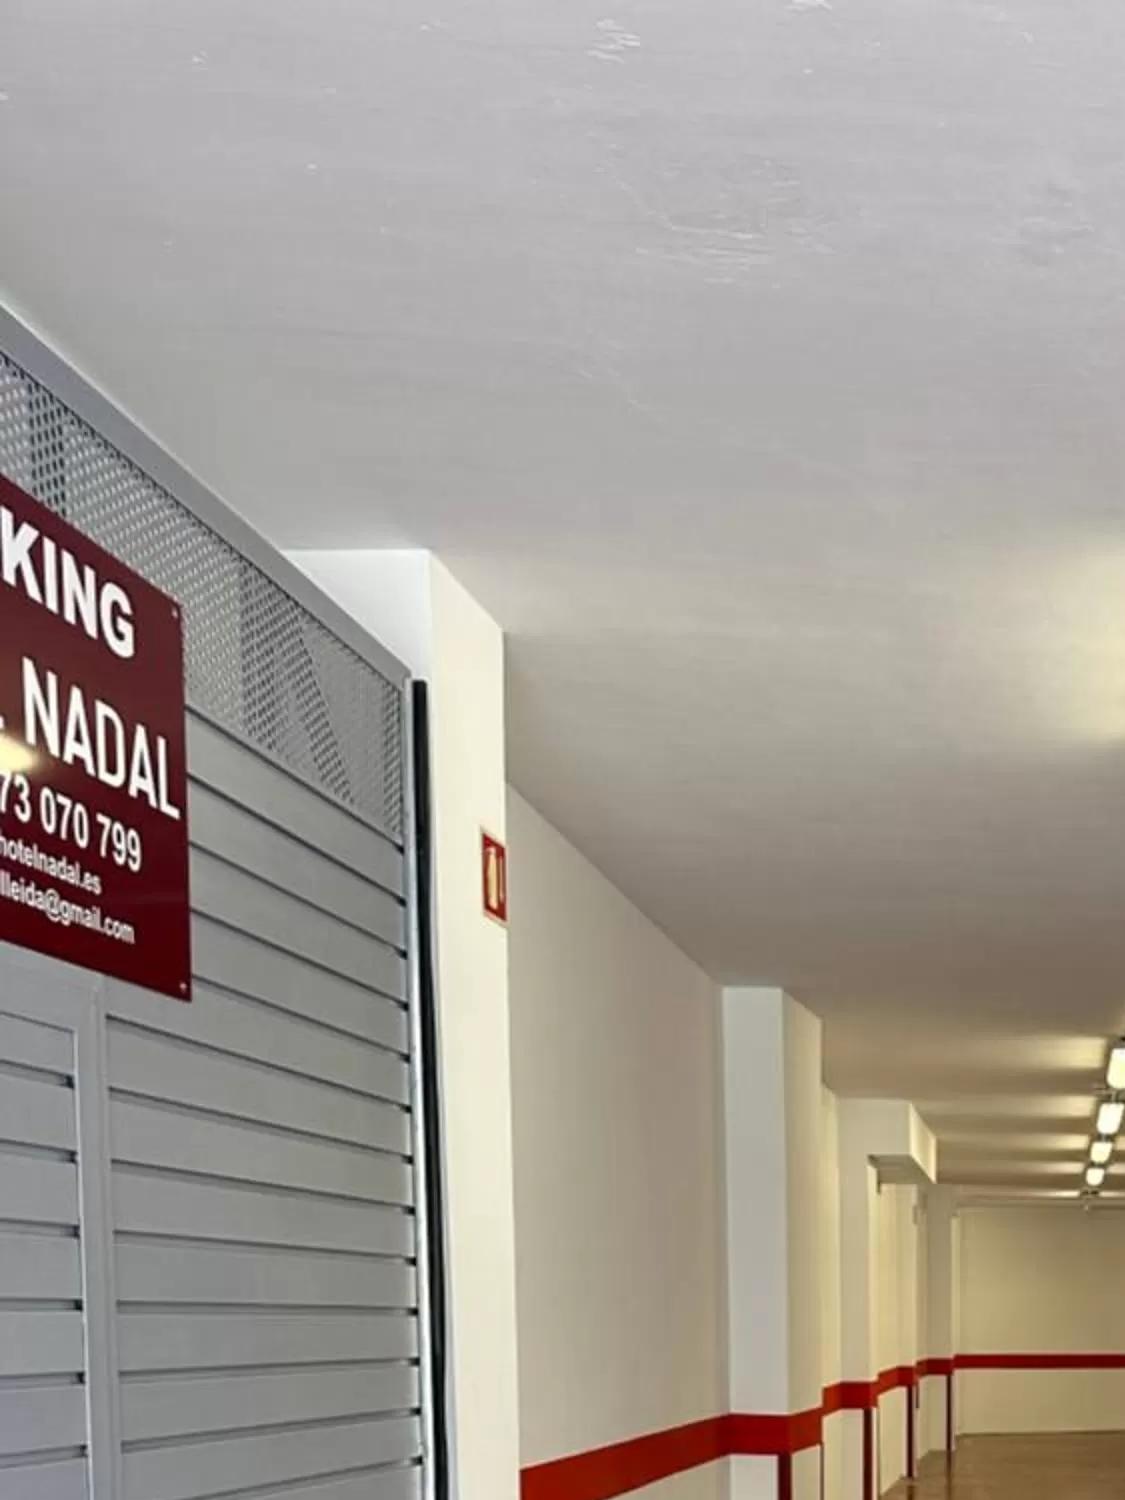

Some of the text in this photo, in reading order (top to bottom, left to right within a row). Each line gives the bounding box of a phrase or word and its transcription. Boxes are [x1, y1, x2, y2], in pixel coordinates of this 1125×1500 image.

[0, 505, 135, 660] KING
[22, 656, 181, 821] NADAL
[0, 769, 142, 873] 73 070 799
